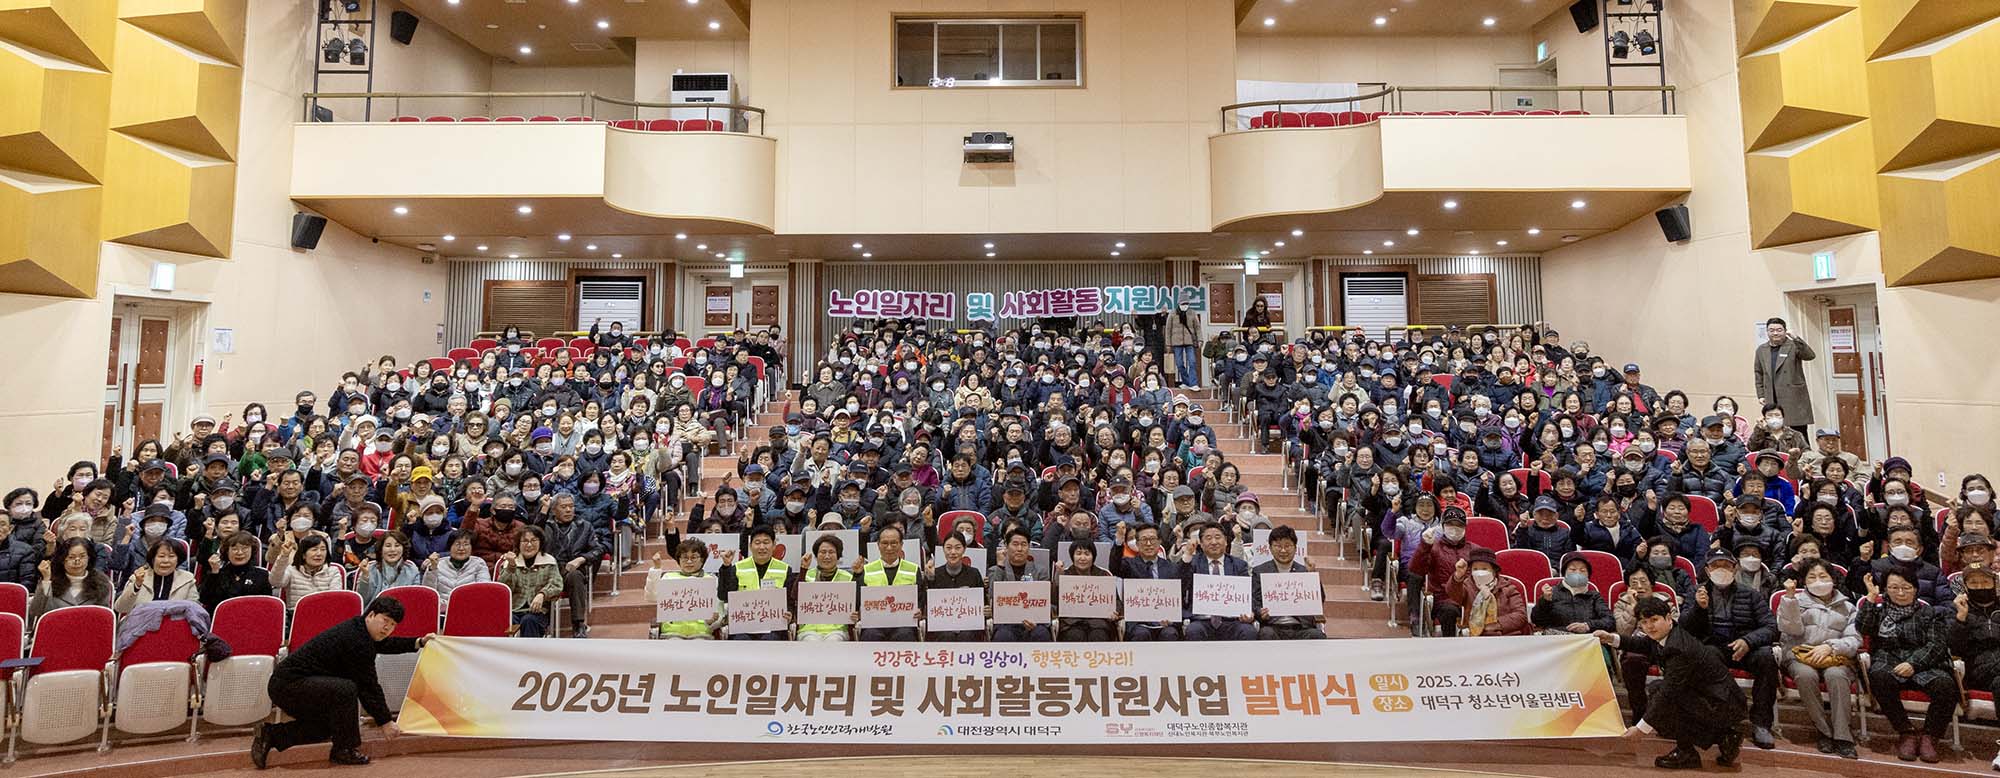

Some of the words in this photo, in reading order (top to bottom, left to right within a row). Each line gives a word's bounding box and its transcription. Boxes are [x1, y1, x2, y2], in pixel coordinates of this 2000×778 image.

[829, 290, 953, 318] 노인일자리
[966, 294, 992, 319] 및
[1000, 289, 1100, 316] 사회활동
[864, 600, 887, 612] 행복한
[890, 602, 914, 613] 일자리
[996, 596, 1020, 607] 행복한
[1022, 598, 1046, 609] 일자리
[873, 651, 921, 667] 건강한
[924, 651, 954, 667] 노후!
[959, 652, 975, 667] 내
[979, 651, 1028, 668] 일상이,
[1032, 650, 1080, 668] 행복한
[1083, 651, 1134, 666] 일자리!
[1375, 675, 1405, 690] 일시
[1417, 675, 1457, 688] 2025.
[512, 671, 656, 714] 2025년
[664, 673, 855, 716] 노인일자리
[870, 675, 904, 716] 및
[917, 675, 1227, 716] 사회활동지원사업
[1241, 673, 1360, 716] 발대식
[1377, 697, 1409, 712] 장소
[1421, 695, 1464, 711] 대덕구
[1468, 692, 1584, 710] 청소년어울림센터
[787, 722, 893, 737] 한국노인인력개발원
[957, 724, 1021, 736] 대전광역시
[1024, 724, 1062, 736] 대덕구
[1167, 722, 1248, 731] 대덕구노인종합복지관
